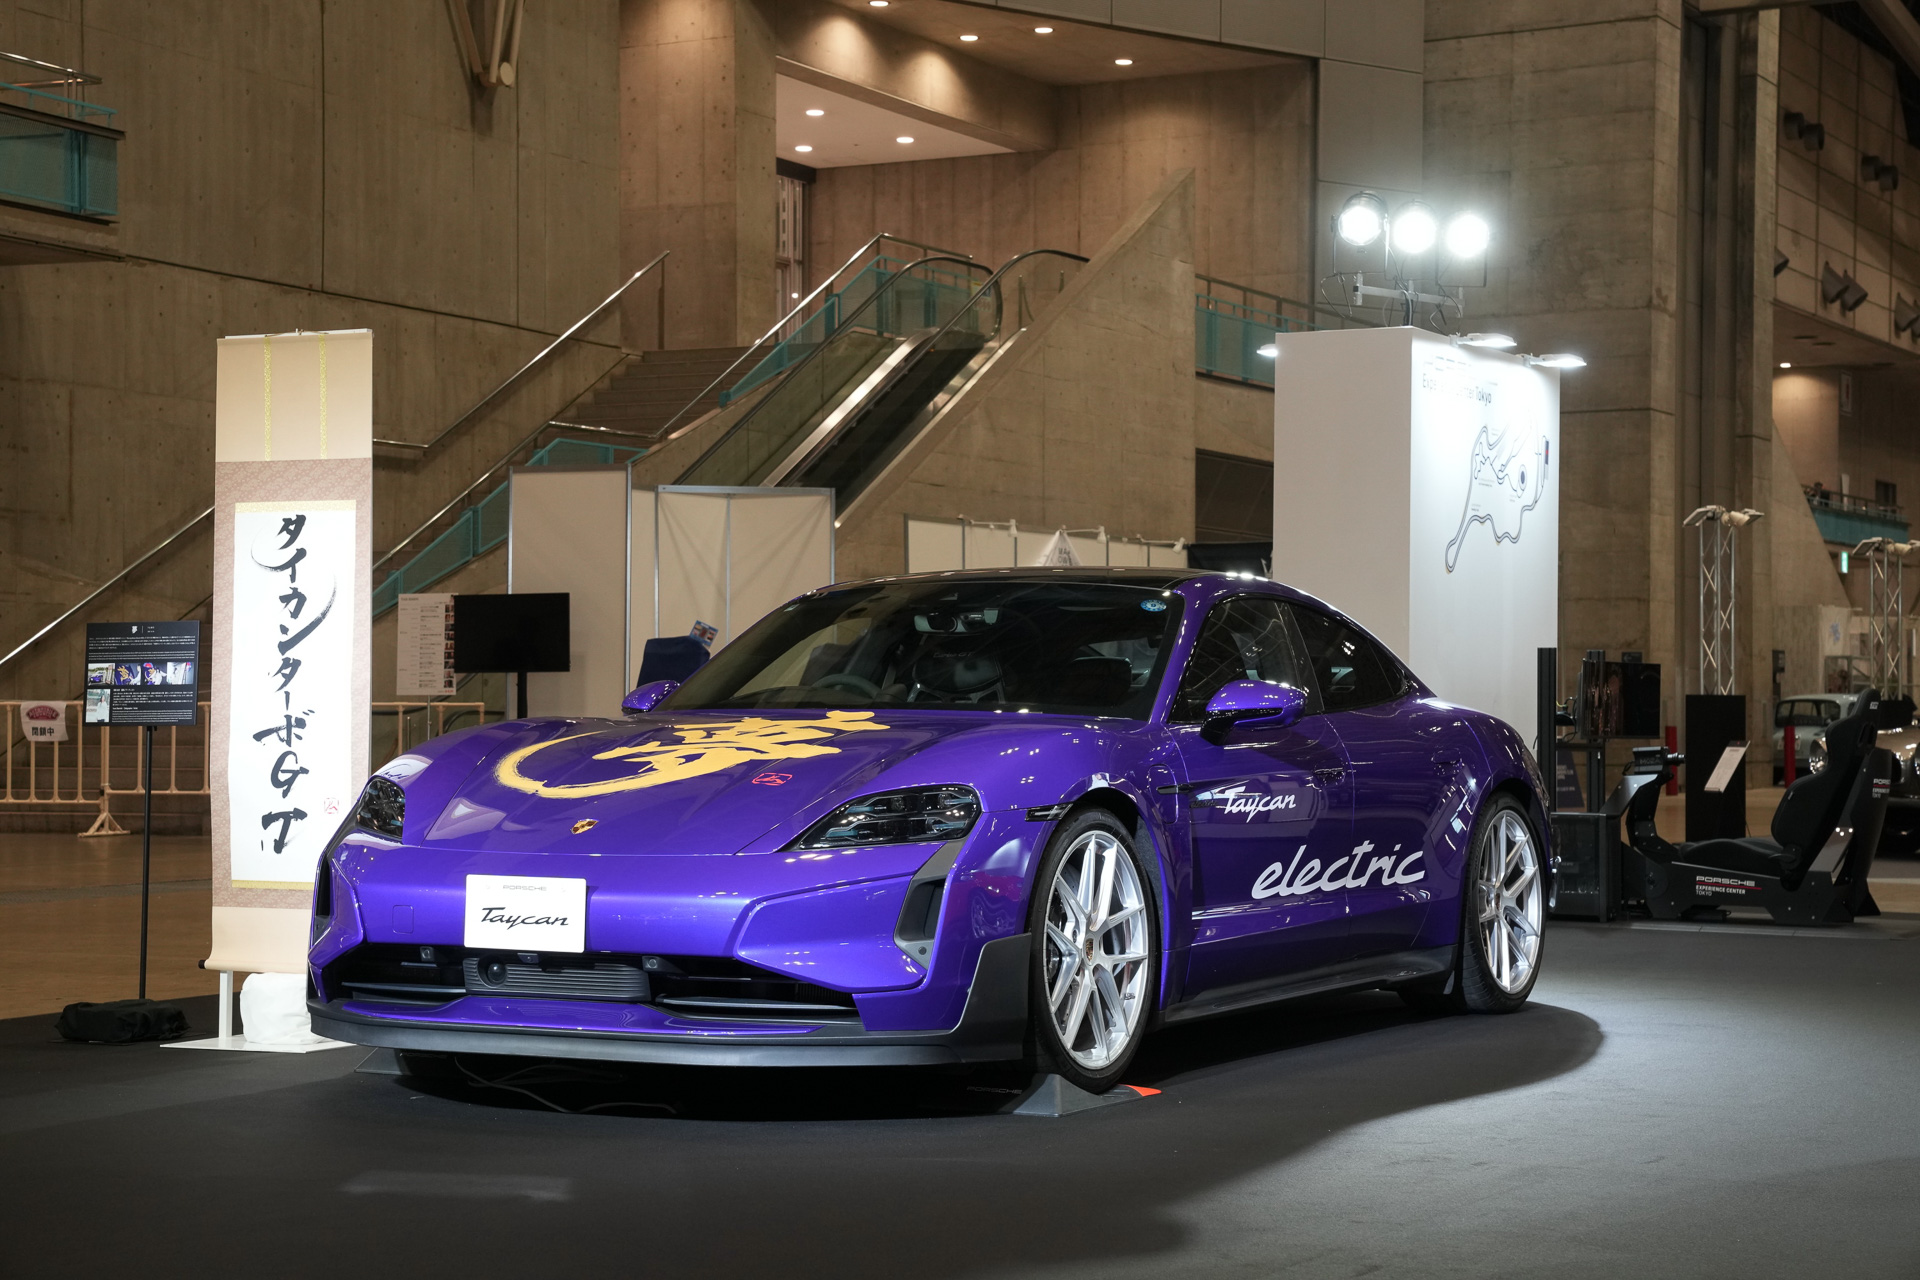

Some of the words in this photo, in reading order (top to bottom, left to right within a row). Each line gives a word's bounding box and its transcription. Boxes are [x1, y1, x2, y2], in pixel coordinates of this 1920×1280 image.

[1475, 386, 1492, 407] Tokyo
[251, 514, 337, 854] タイカンターボGT
[1224, 786, 1297, 823] Taycan
[1251, 840, 1426, 900] electric
[1696, 875, 1756, 887] PORSCHE
[502, 884, 548, 892] PORSCHE
[1695, 885, 1726, 893] EXPERIENCE
[480, 906, 569, 931] Taycan
